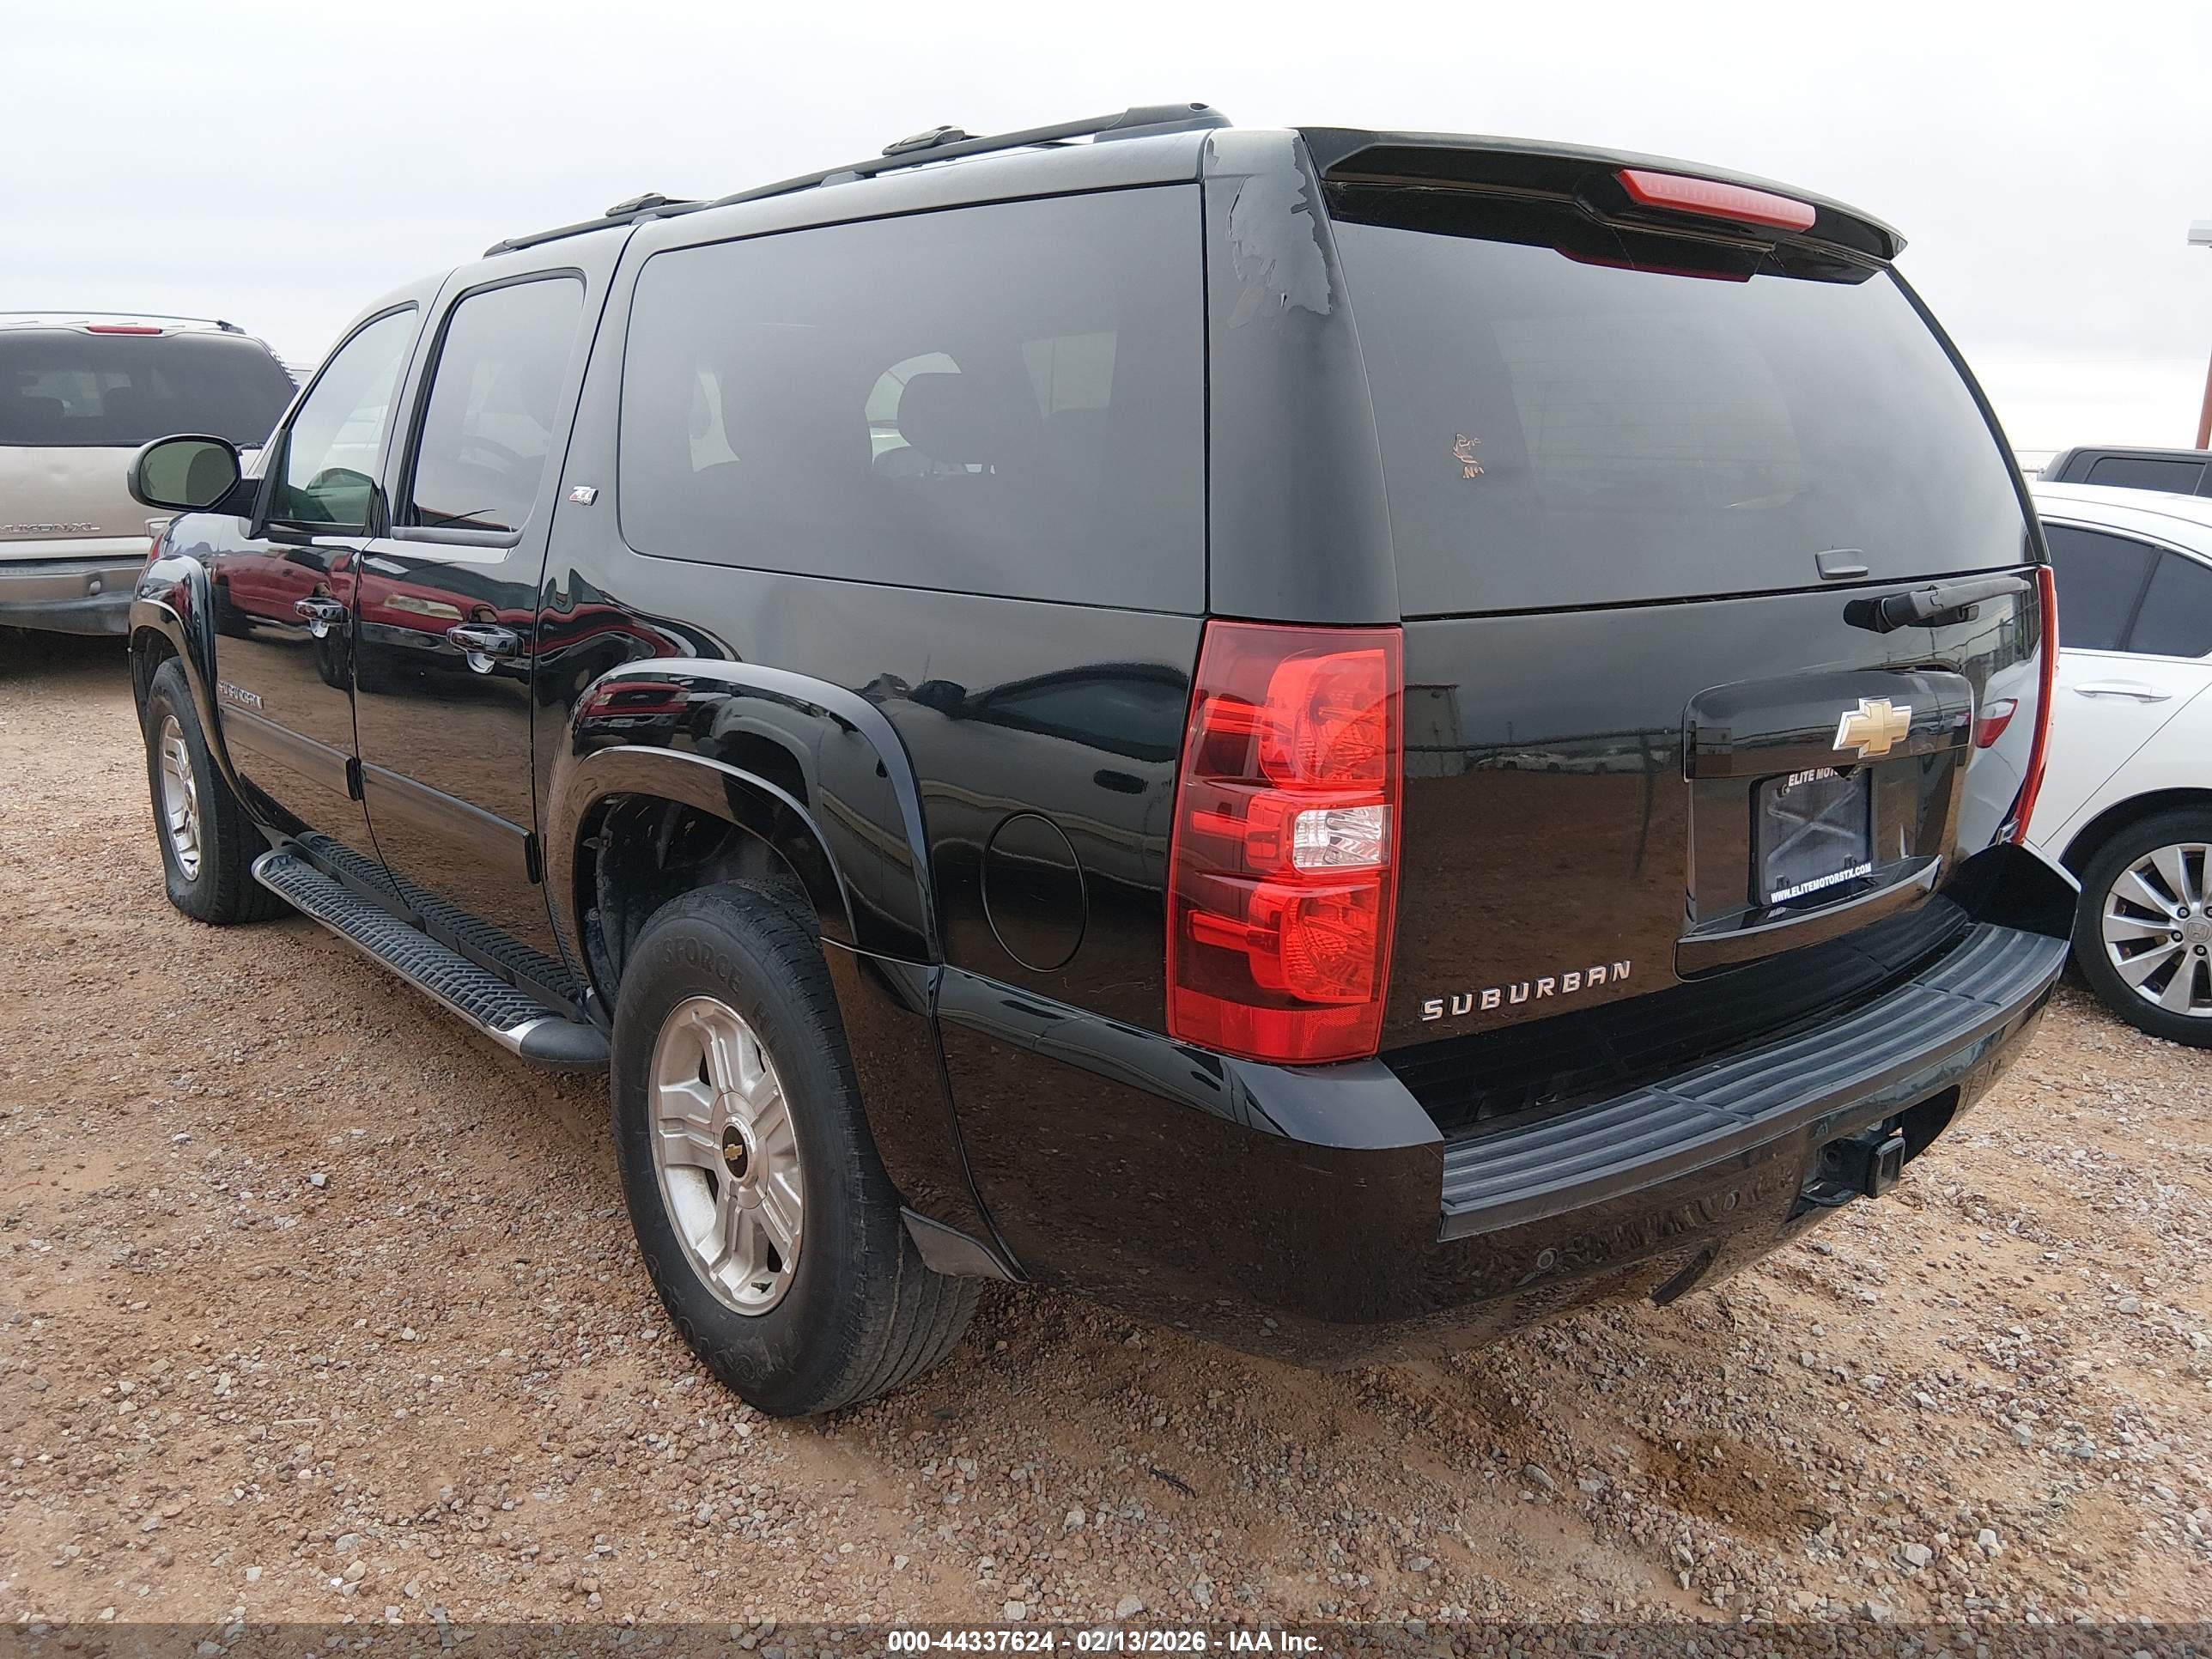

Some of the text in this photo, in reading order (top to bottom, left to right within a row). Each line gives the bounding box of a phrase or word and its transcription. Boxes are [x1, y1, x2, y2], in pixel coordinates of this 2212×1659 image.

[70, 522, 100, 532] XL
[1788, 769, 1816, 787] ELITE
[1771, 862, 1872, 904] WWW.ELITEMOTORSTX.COM
[1421, 960, 1631, 1022] SUBURBAN
